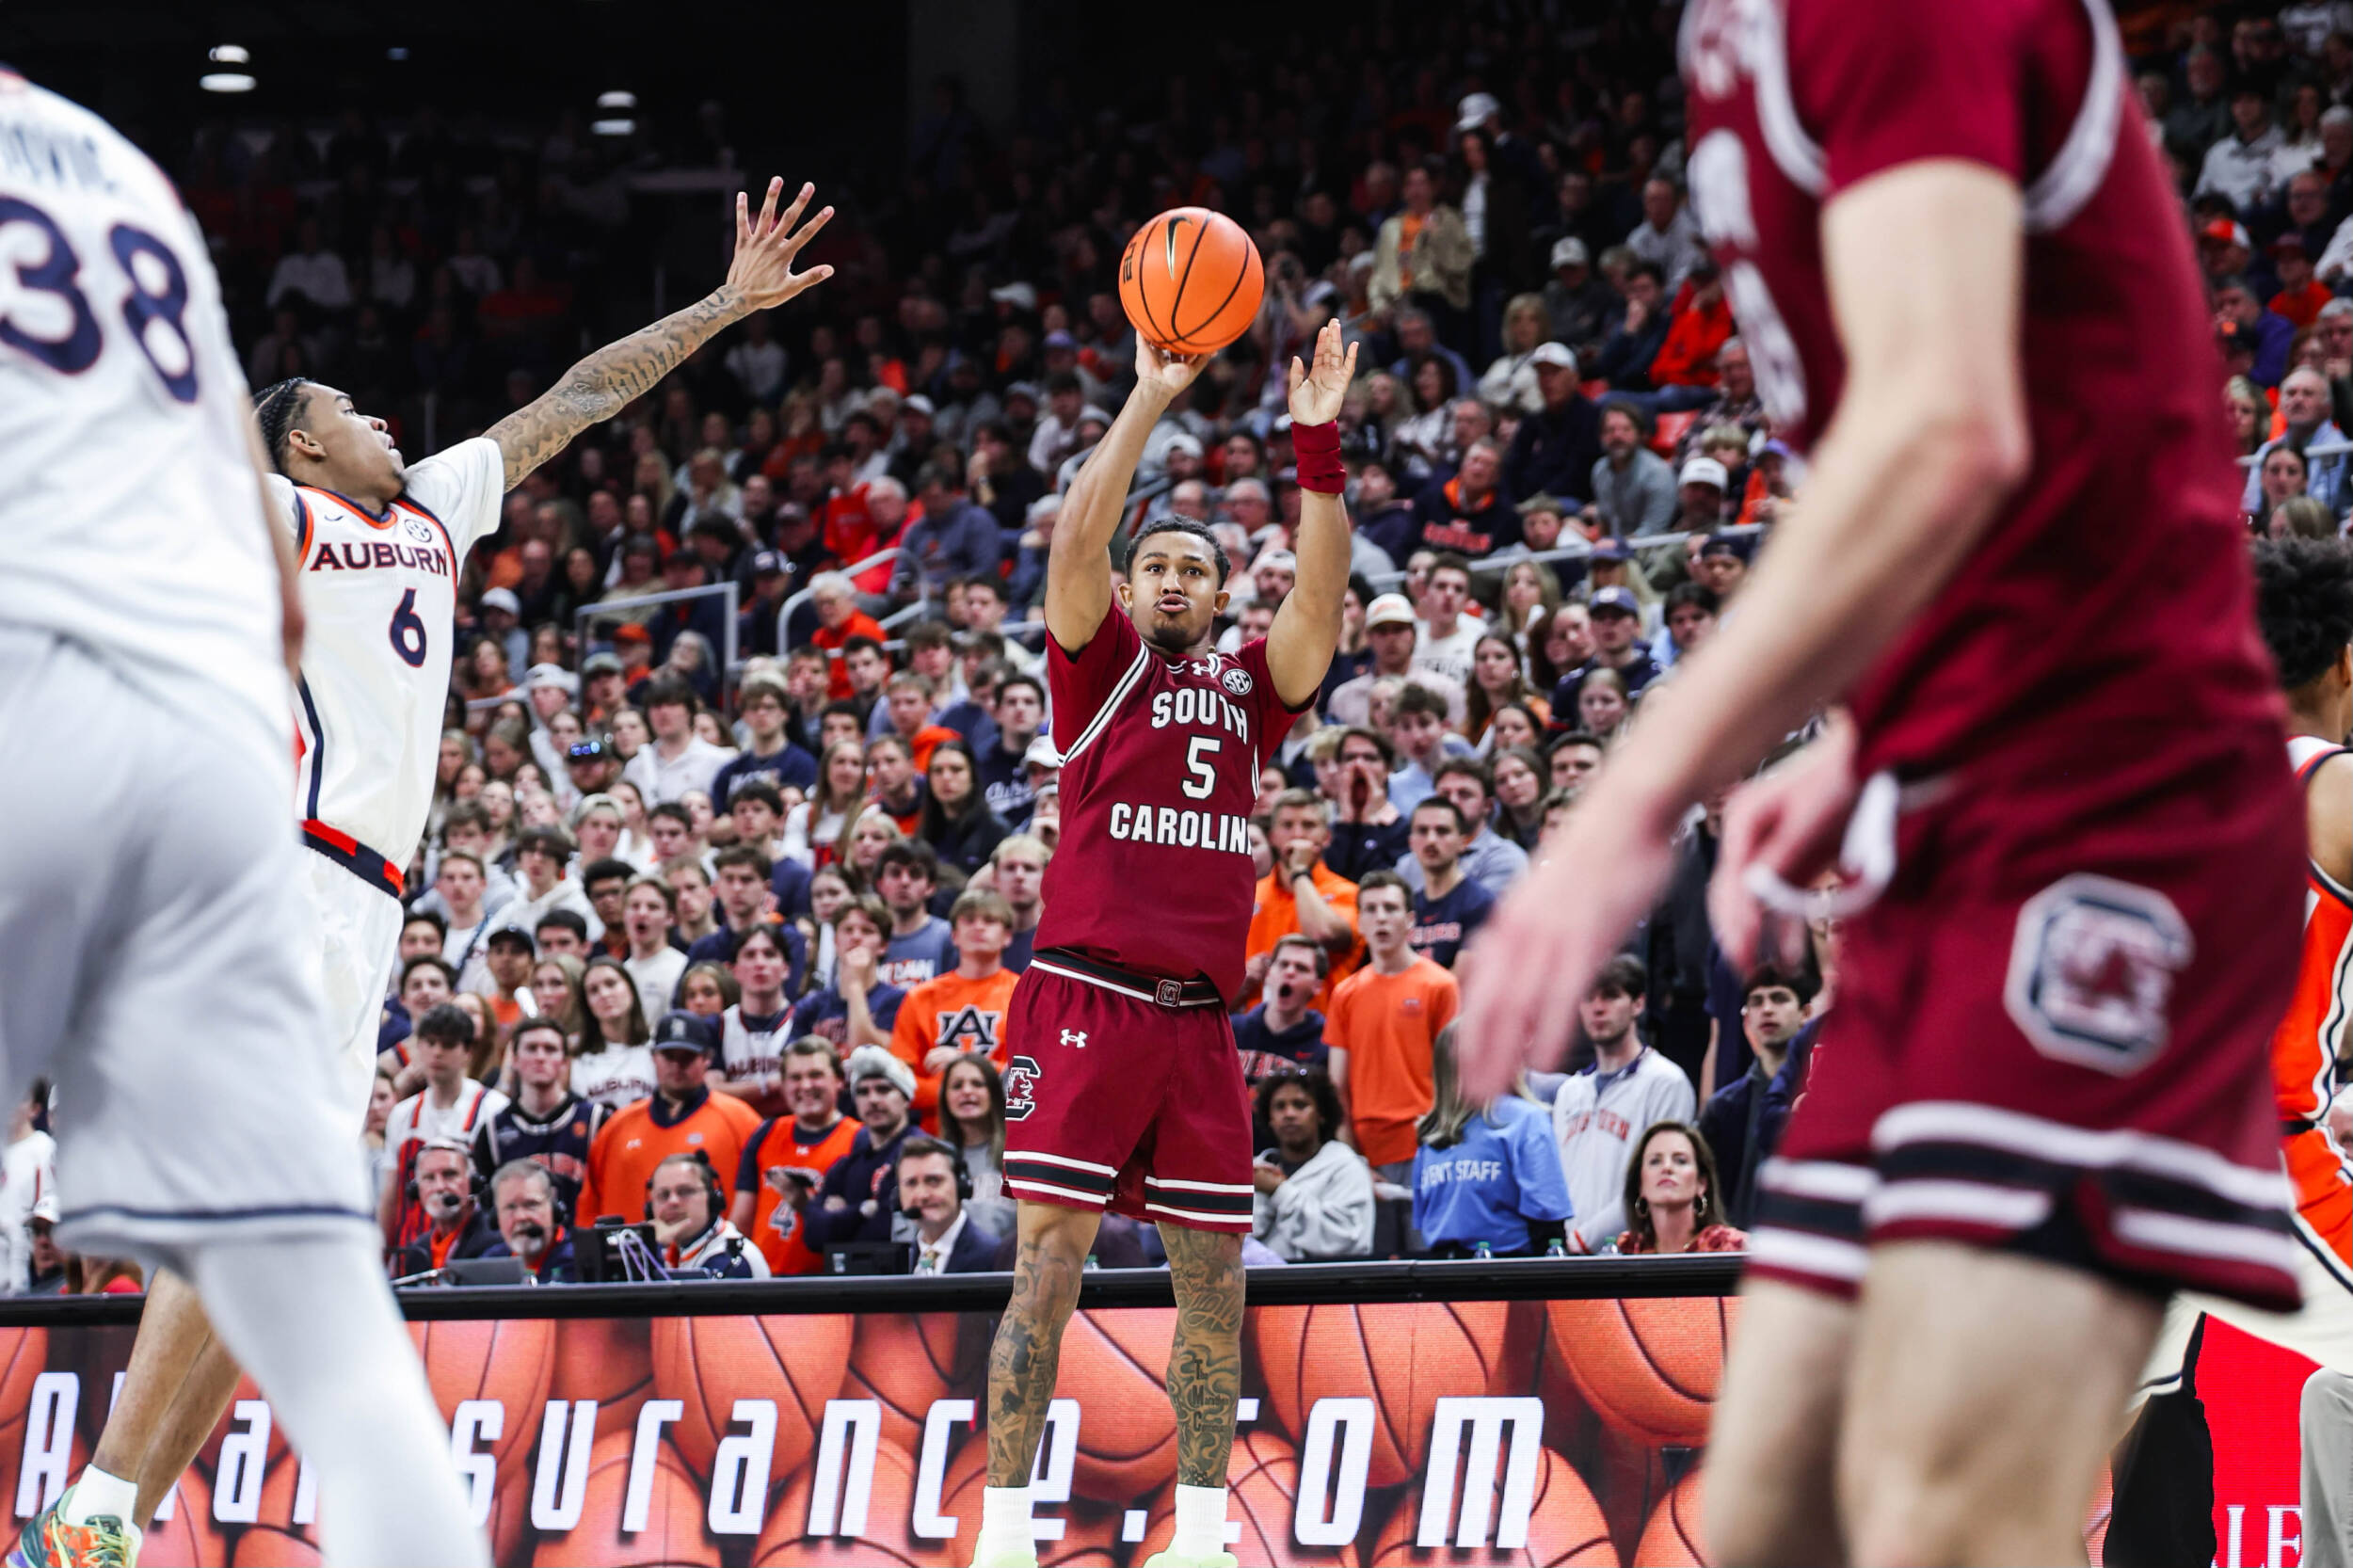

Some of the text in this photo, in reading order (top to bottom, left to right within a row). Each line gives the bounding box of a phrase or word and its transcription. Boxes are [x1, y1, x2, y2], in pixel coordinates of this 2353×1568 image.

[0, 194, 198, 403] 38
[310, 542, 448, 576] AUBURN
[389, 587, 427, 668] 6
[1223, 669, 1252, 695] SEC
[1151, 688, 1248, 745] SOUTH
[1181, 735, 1221, 800] 5
[1454, 1160, 1502, 1182] STAFF
